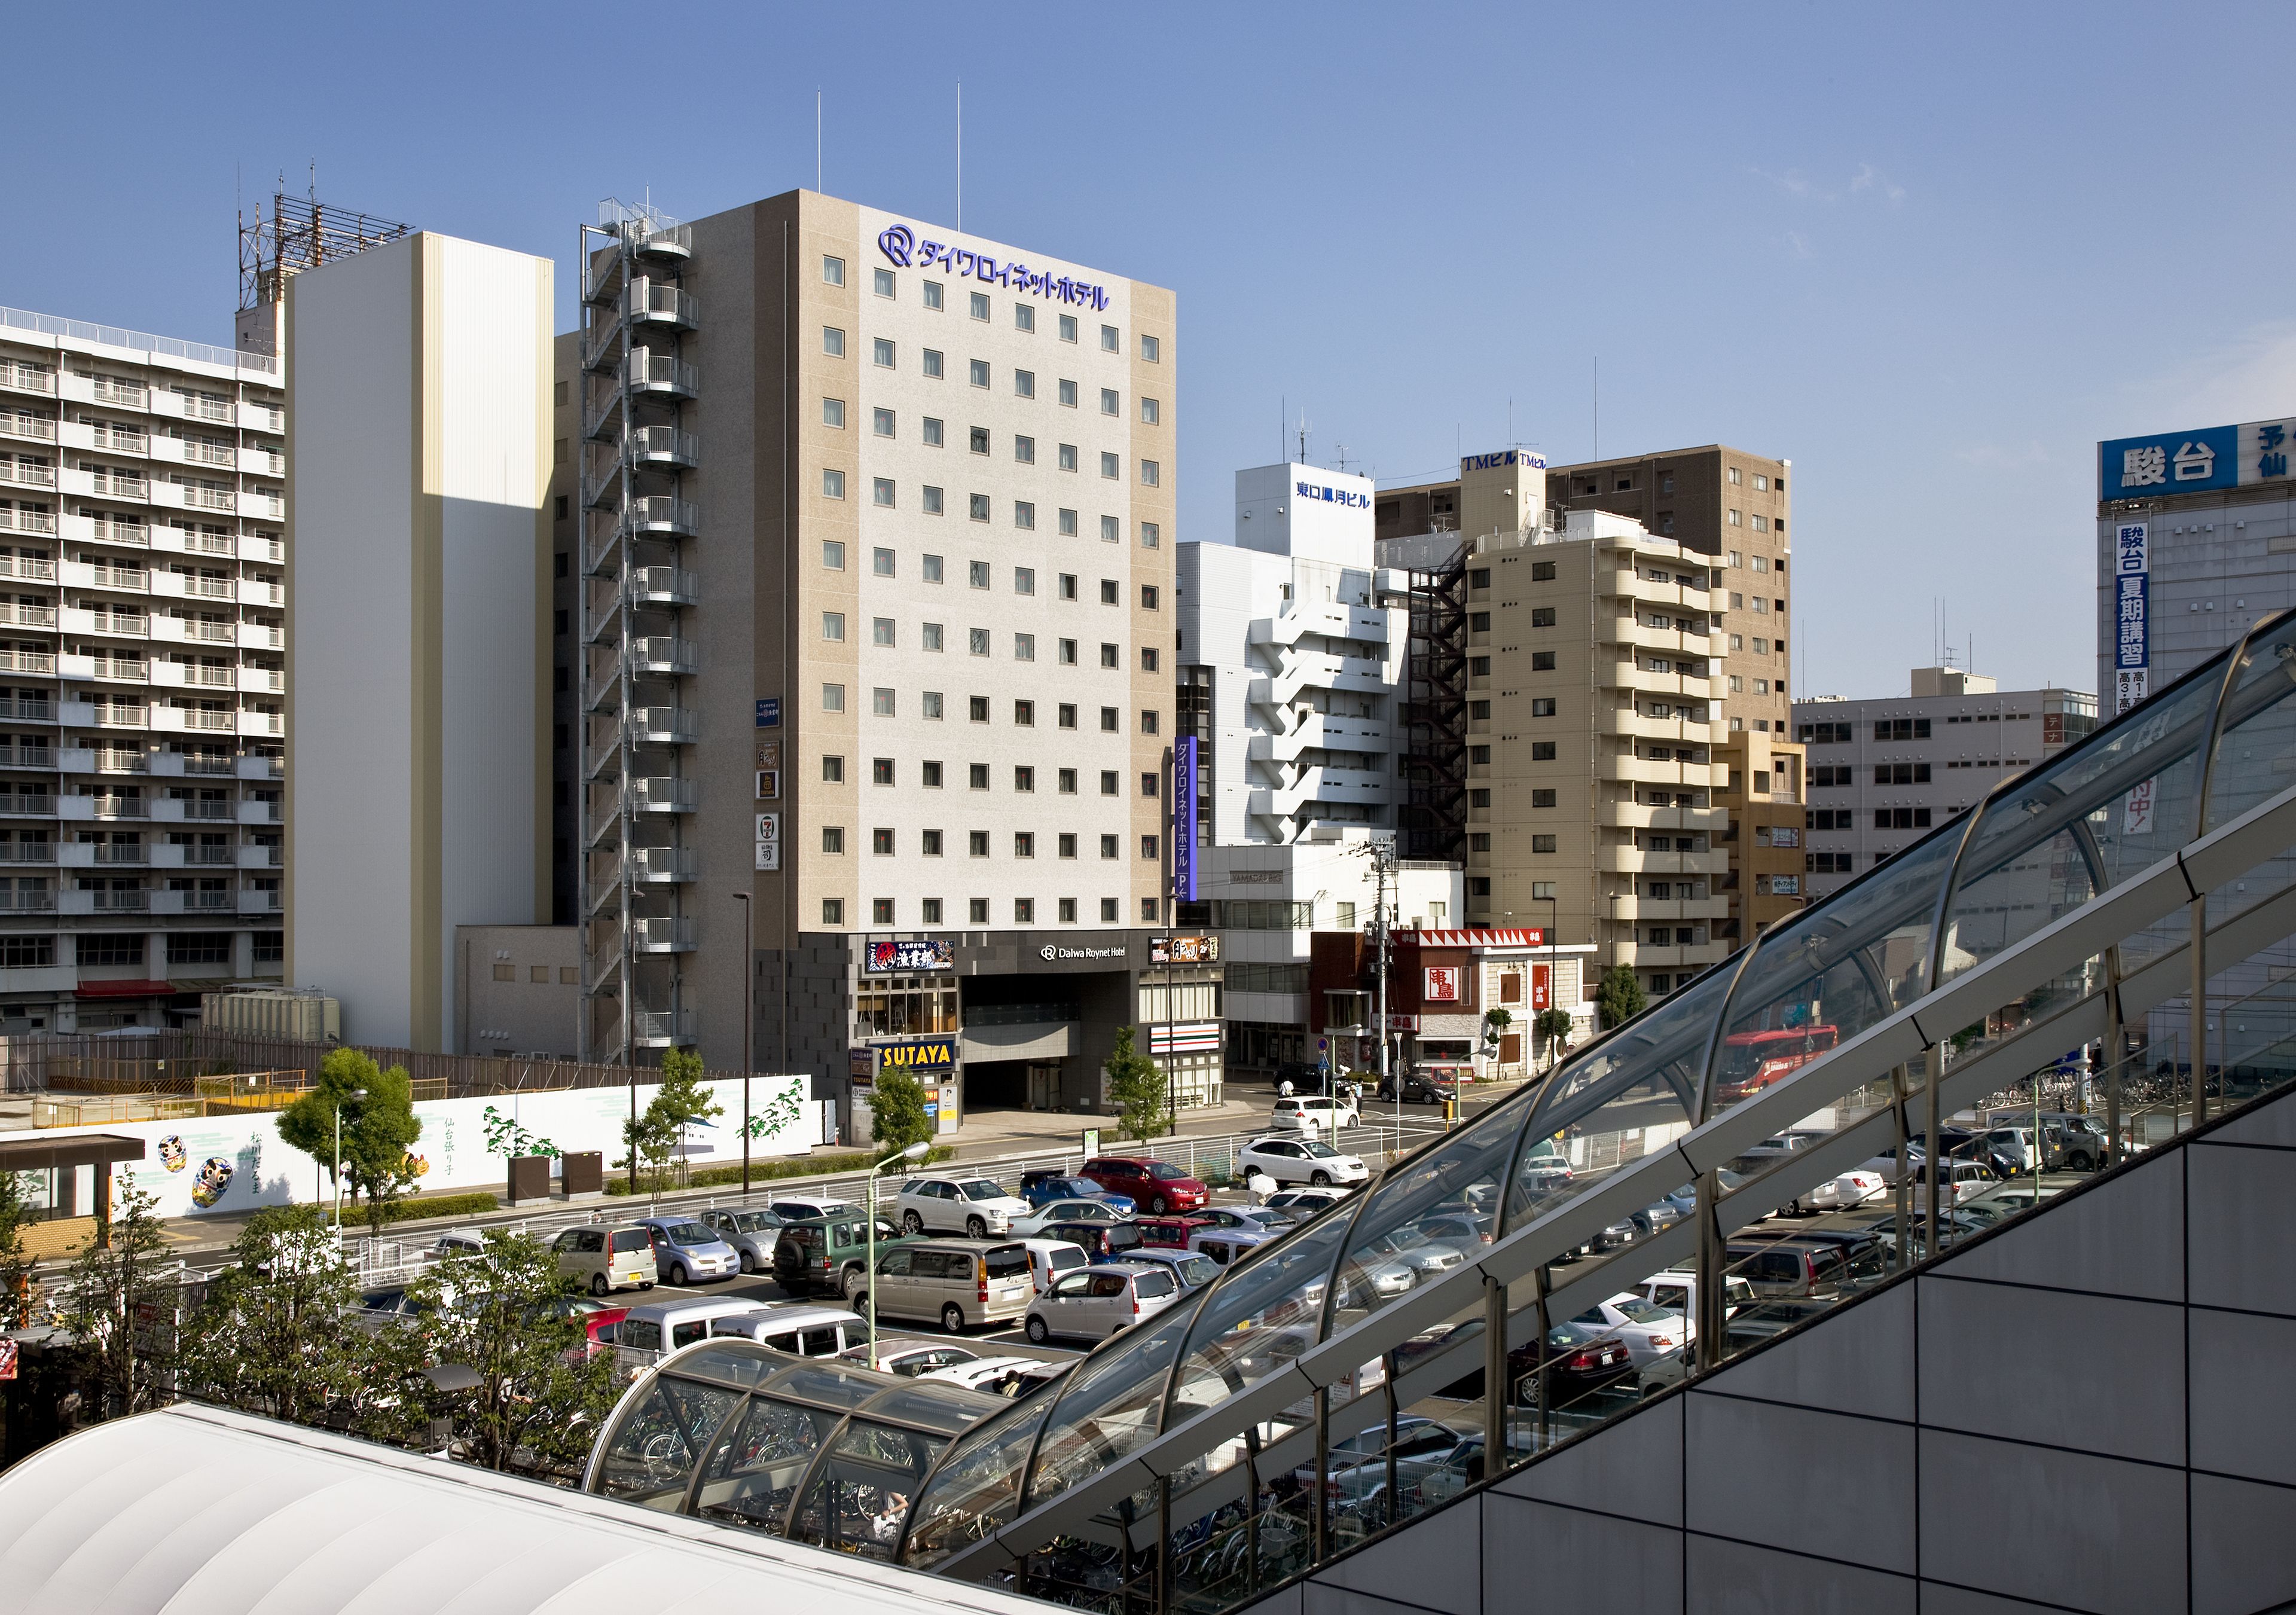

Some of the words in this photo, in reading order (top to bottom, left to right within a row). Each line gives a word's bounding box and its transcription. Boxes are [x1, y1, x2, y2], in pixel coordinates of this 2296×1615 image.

[917, 240, 1110, 310] ダイワロイネットホテル
[2258, 425, 2296, 450] 予
[1463, 451, 1517, 471] TMビル
[1519, 453, 1546, 470] TMビル
[2121, 442, 2215, 487] 駿台
[2120, 527, 2144, 570] 駿台
[2120, 576, 2144, 665] 夏期講習
[2119, 673, 2130, 713] 高3・高
[1177, 743, 1190, 868] ダイワロイネットホテル
[1178, 875, 1186, 887] P
[1529, 932, 1541, 942] 串鳥
[897, 950, 932, 969] 漁業部
[1058, 948, 1085, 958] Daiwa
[1085, 947, 1111, 960] Roynet
[1111, 947, 1125, 957] Hotel
[1431, 969, 1455, 999] 串鳥
[1535, 985, 1544, 1003] 串鳥
[1392, 1015, 1412, 1028] 串鳥
[879, 1045, 951, 1067] SUTAYA
[444, 1118, 454, 1176] 仙台張り子
[250, 1131, 263, 1195] 松川だるま
